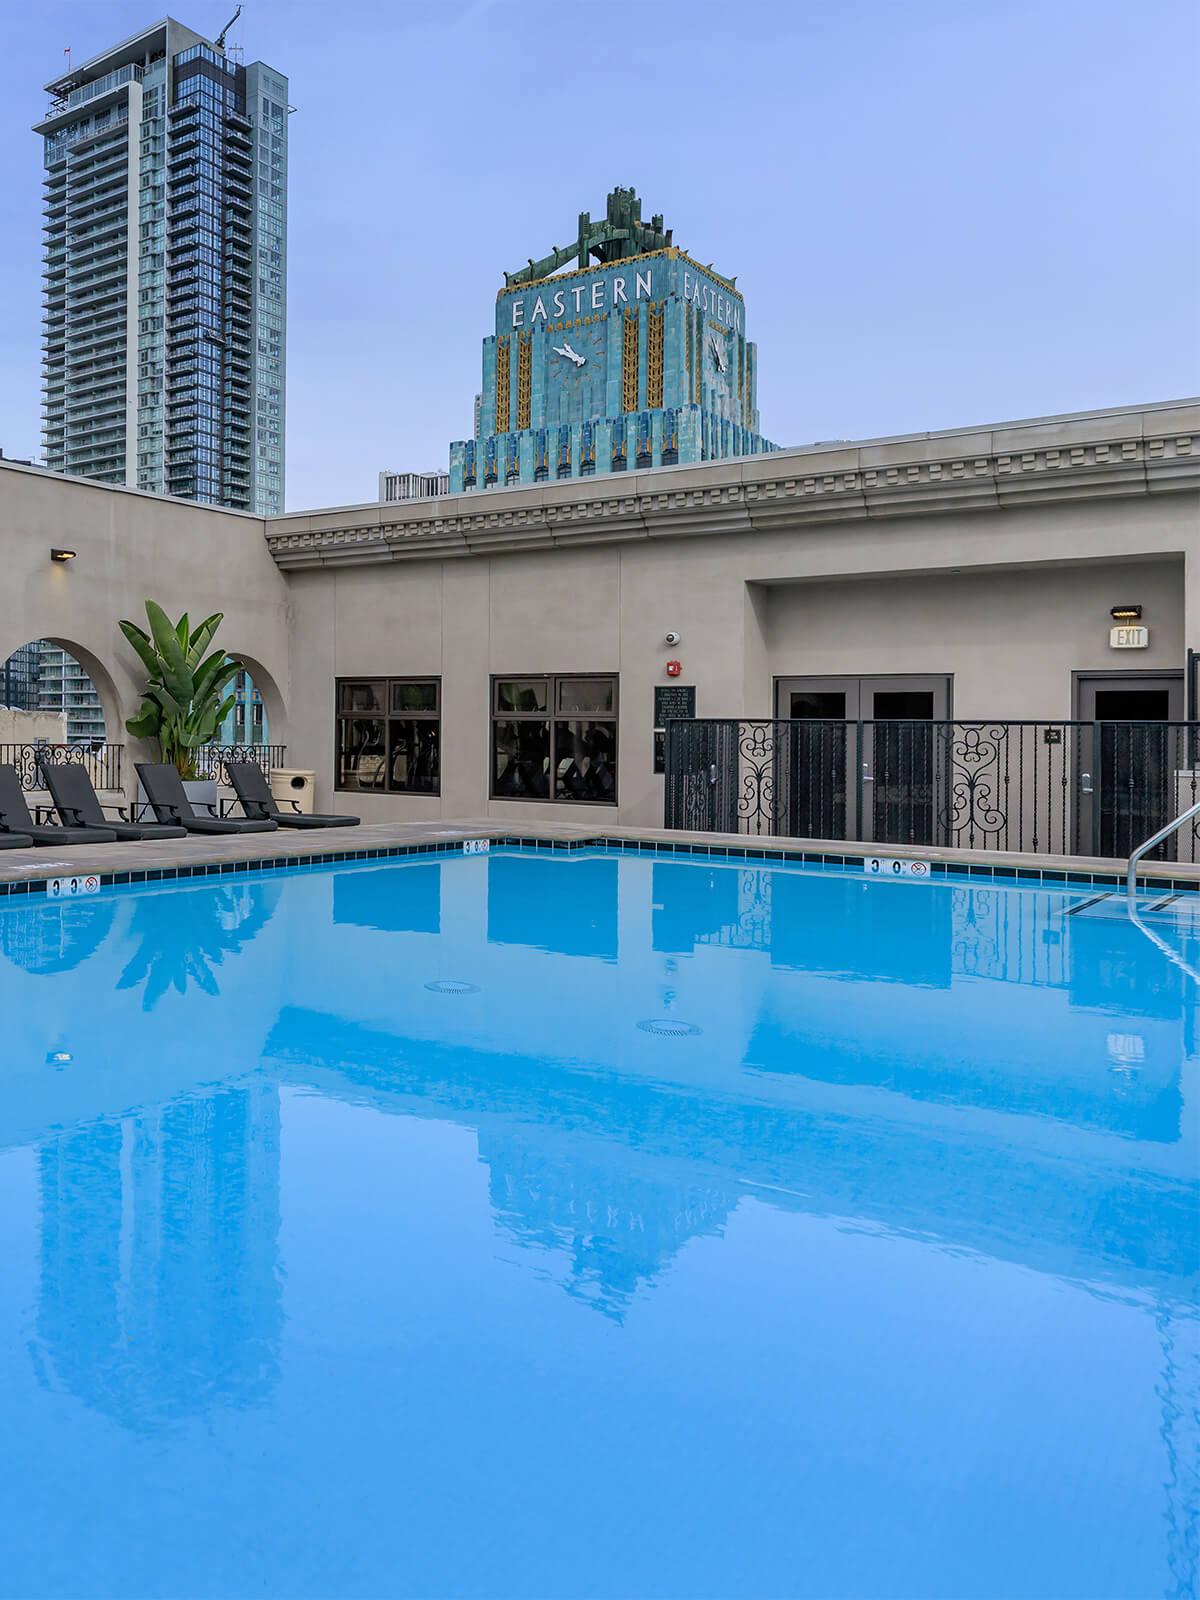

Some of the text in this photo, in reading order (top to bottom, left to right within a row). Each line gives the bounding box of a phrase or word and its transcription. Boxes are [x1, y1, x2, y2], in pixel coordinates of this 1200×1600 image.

[512, 270, 652, 328] EASTERN
[684, 271, 741, 332] EASTERN
[1117, 629, 1144, 646] EXIT
